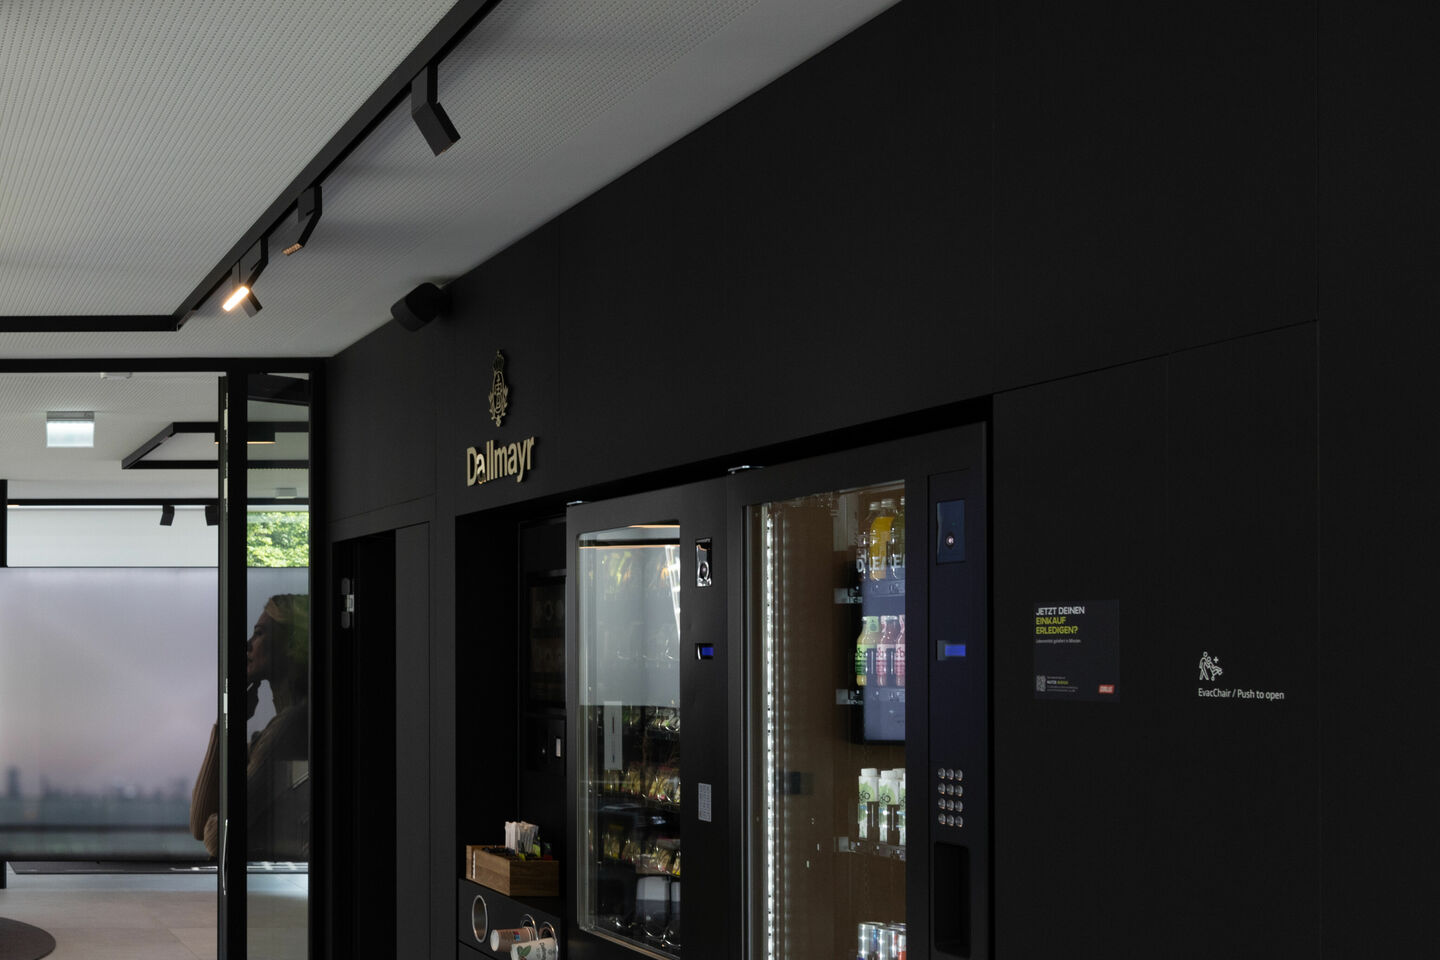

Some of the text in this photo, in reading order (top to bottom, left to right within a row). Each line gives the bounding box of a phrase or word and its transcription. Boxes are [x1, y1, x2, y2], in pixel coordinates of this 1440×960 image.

[467, 436, 535, 487] Dallmayr
[1036, 606, 1085, 616] JETZT DEINEN
[1036, 616, 1066, 625] EINKAUF
[1036, 626, 1078, 635] ERLEDIGEN?
[1198, 688, 1231, 697] EvacChair
[1237, 689, 1255, 699] Push
[1256, 690, 1264, 699] to
[1265, 692, 1285, 701] open
